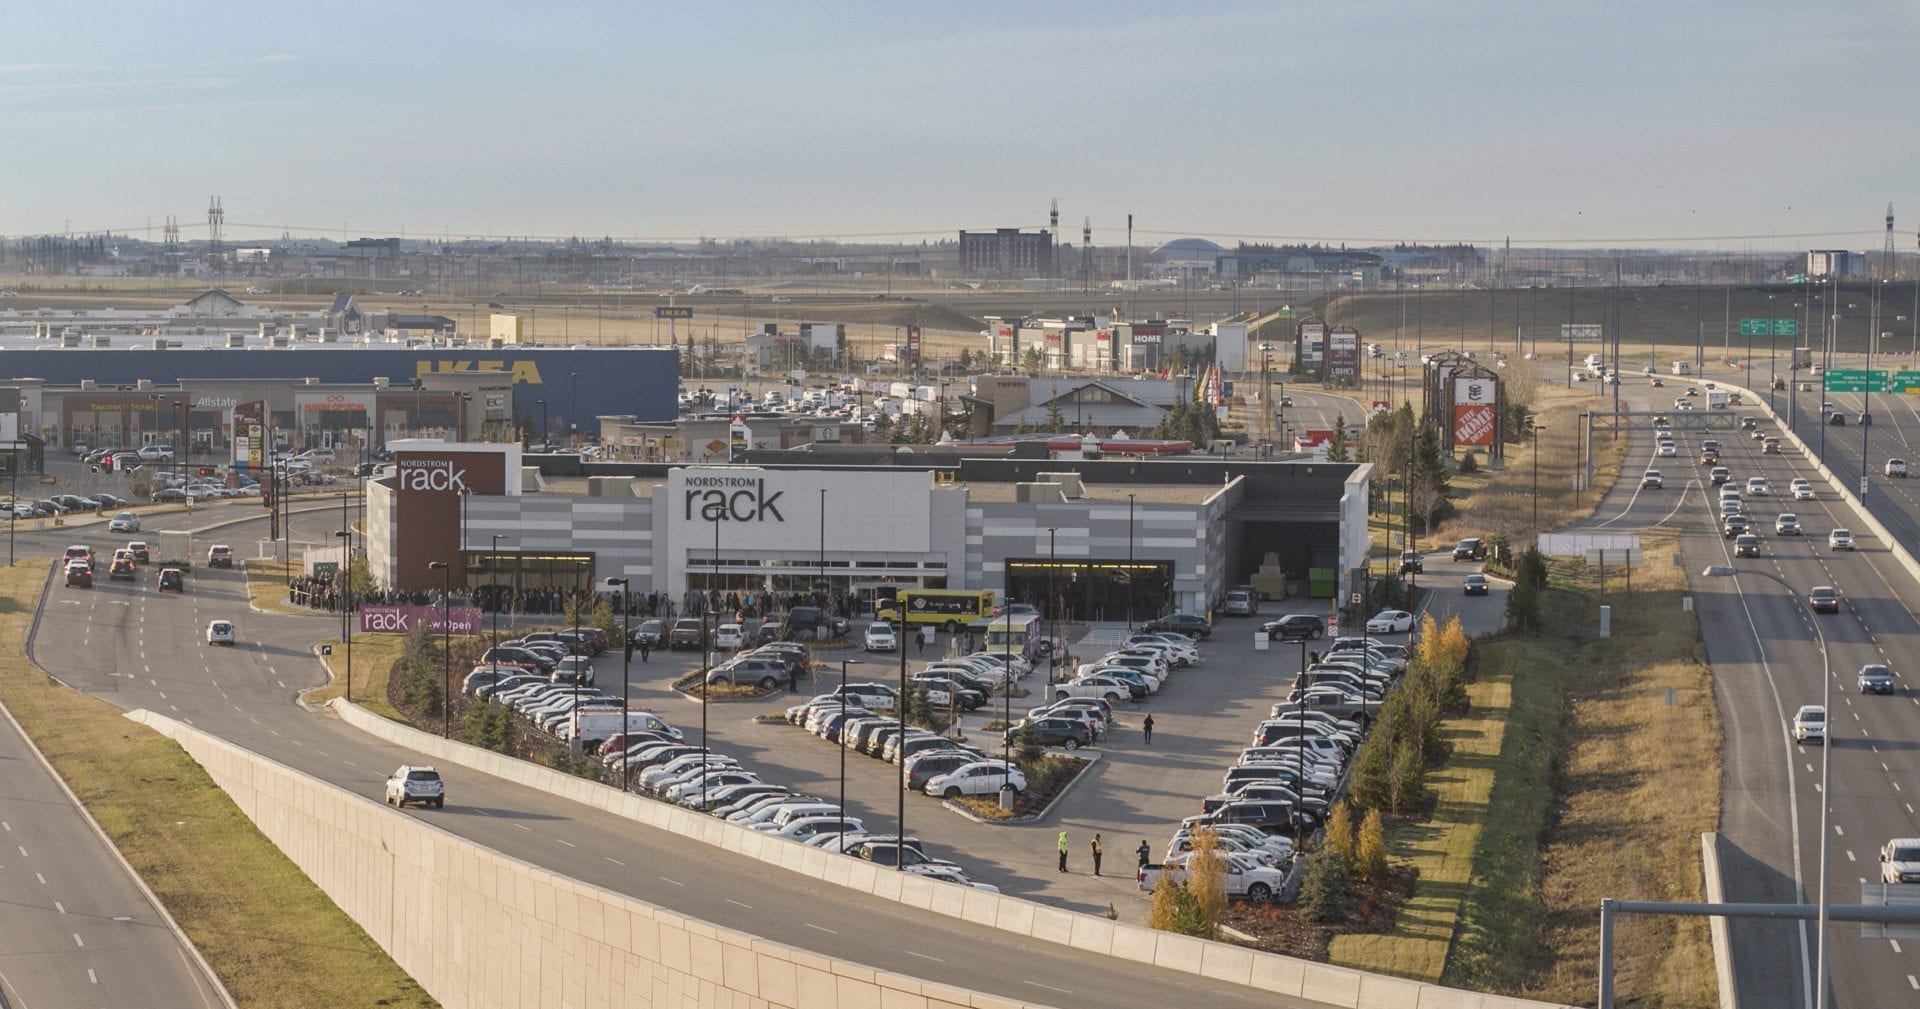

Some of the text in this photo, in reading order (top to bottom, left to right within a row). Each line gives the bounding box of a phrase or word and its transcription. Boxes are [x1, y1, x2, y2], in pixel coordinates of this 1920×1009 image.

[197, 396, 237, 408] Allstate
[486, 398, 502, 407] EC
[1456, 407, 1494, 442] HOME
[401, 461, 466, 490] rack
[686, 477, 756, 487] NORDSTROM
[686, 478, 785, 522] rack
[365, 608, 408, 630] rack
[444, 619, 472, 632] Open
